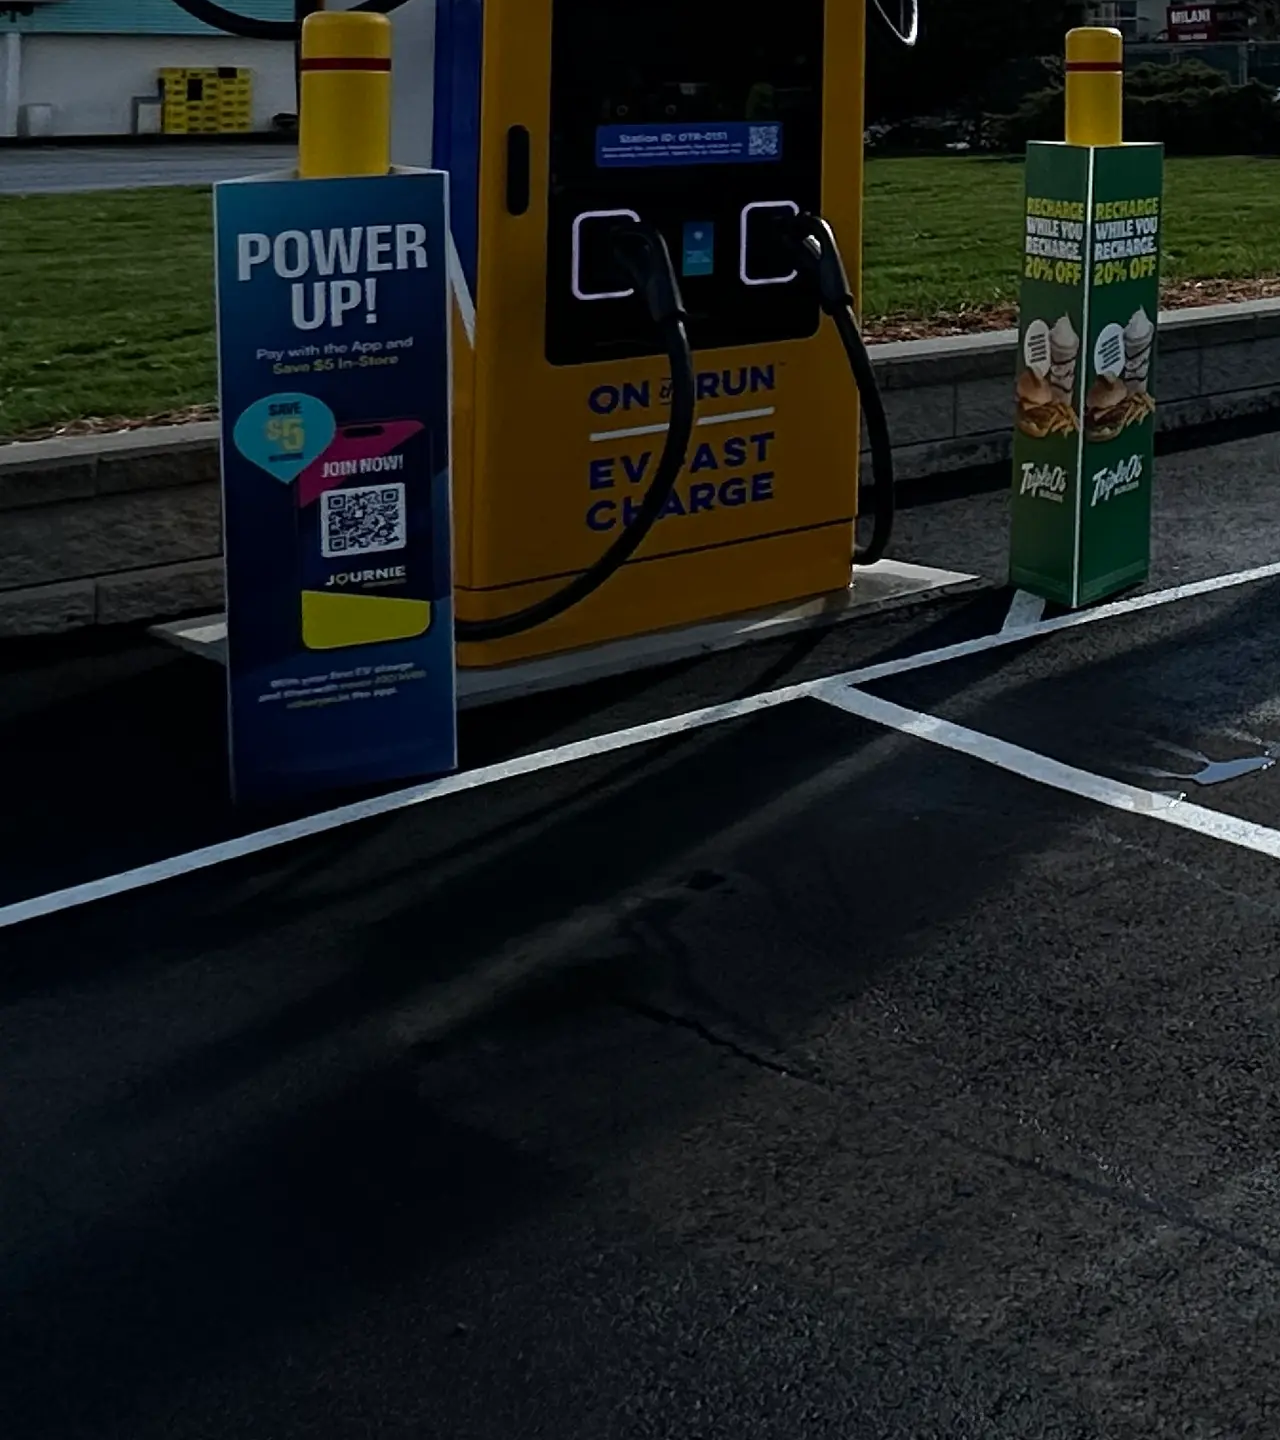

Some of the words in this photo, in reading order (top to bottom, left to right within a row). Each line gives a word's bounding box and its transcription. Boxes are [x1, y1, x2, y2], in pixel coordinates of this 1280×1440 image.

[1027, 197, 1084, 221] RECHARGE
[1094, 197, 1159, 221] RECHARGE
[1026, 216, 1060, 238] WHILE
[1060, 221, 1083, 241] YOU
[1094, 219, 1134, 240] WHILE
[1135, 216, 1158, 236] YOU
[237, 223, 428, 281] POWER
[1025, 255, 1053, 282] 20%
[1055, 260, 1082, 286] OFF
[1093, 259, 1127, 286] 20%
[1129, 255, 1156, 280] OFF
[291, 277, 378, 330] UP!
[256, 348, 284, 362] Pay
[288, 345, 320, 357] with
[324, 343, 348, 355] the
[351, 341, 383, 354] App
[385, 336, 414, 348] and
[272, 363, 310, 375] Save
[313, 358, 335, 371] $5
[588, 380, 649, 414] ON
[697, 365, 776, 400] RUN
[266, 418, 305, 450] $5
[320, 459, 358, 478] JOIN
[359, 454, 404, 474] NOW!
[590, 452, 652, 490] EV
[682, 432, 775, 474] AST
[324, 564, 407, 586] JOURNIE
